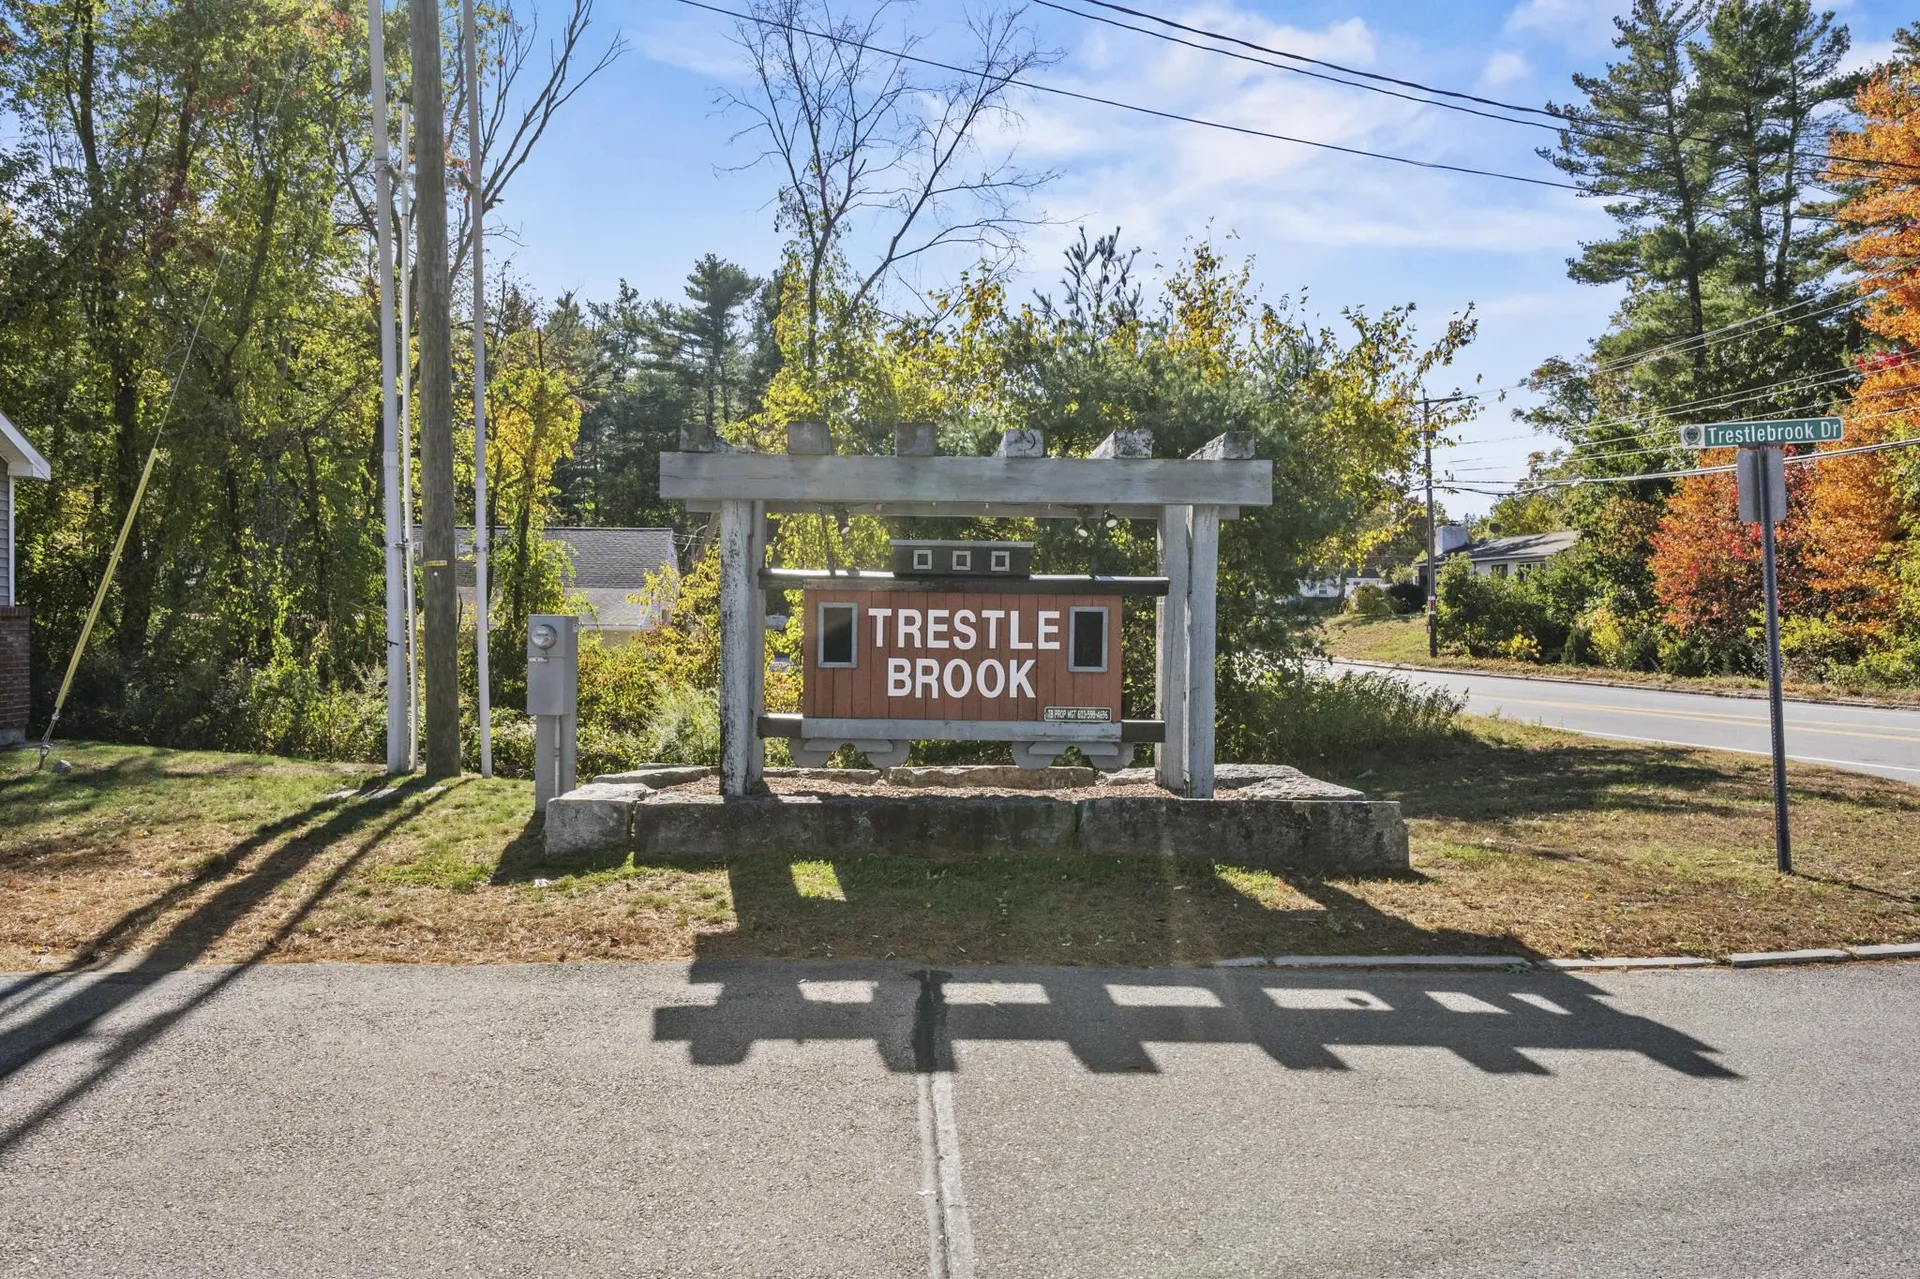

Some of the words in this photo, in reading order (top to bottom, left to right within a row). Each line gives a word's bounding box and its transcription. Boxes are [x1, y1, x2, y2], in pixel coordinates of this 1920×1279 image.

[1708, 422, 1814, 444] Trestlebrook
[1820, 420, 1839, 438] Dr
[868, 608, 1060, 650] TRESTLE
[887, 657, 1036, 699] BROOK
[1054, 710, 1066, 718] PROP
[1067, 710, 1076, 718] MGT
